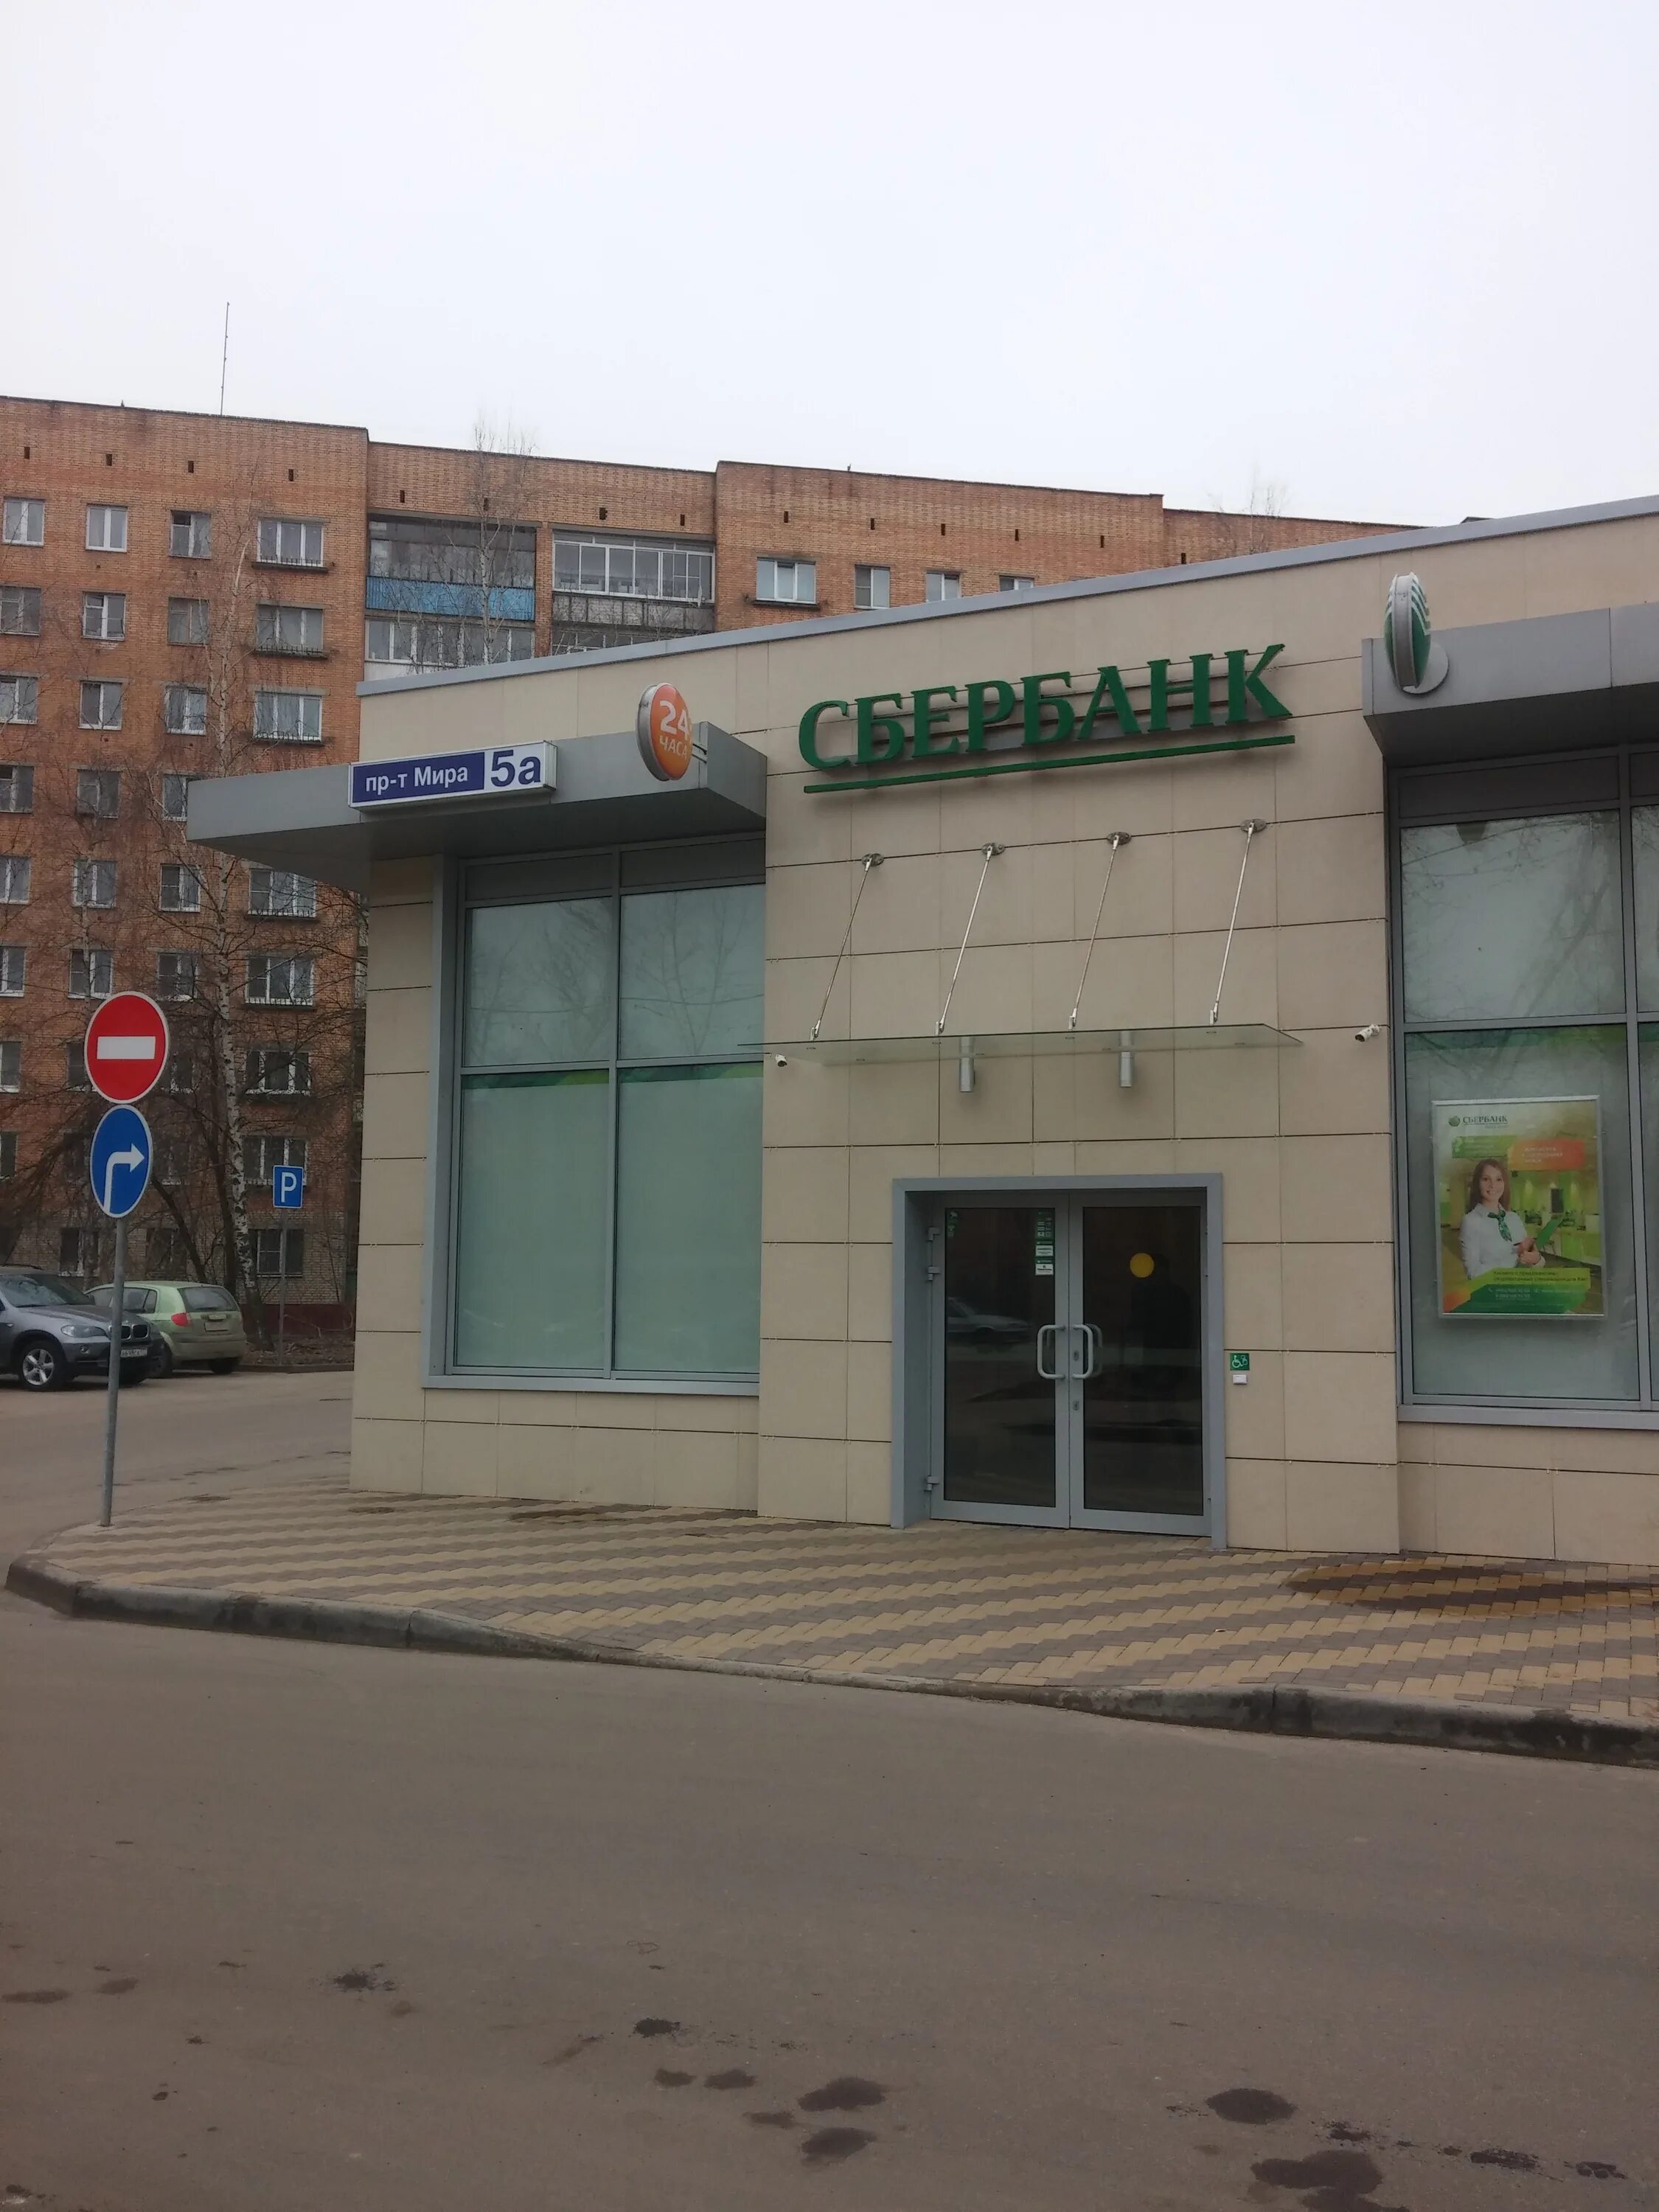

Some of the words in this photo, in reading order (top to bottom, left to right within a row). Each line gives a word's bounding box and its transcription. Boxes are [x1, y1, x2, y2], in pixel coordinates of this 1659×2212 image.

[660, 700, 692, 741] 24
[799, 643, 1293, 771] СБЕРБАНК
[659, 735, 688, 759] ЧАСА
[366, 773, 408, 796] пр-т
[414, 765, 468, 788] Мира
[490, 749, 541, 787] 5а
[1462, 1115, 1508, 1124] СБЕРБАНК
[281, 1172, 297, 1203] P
